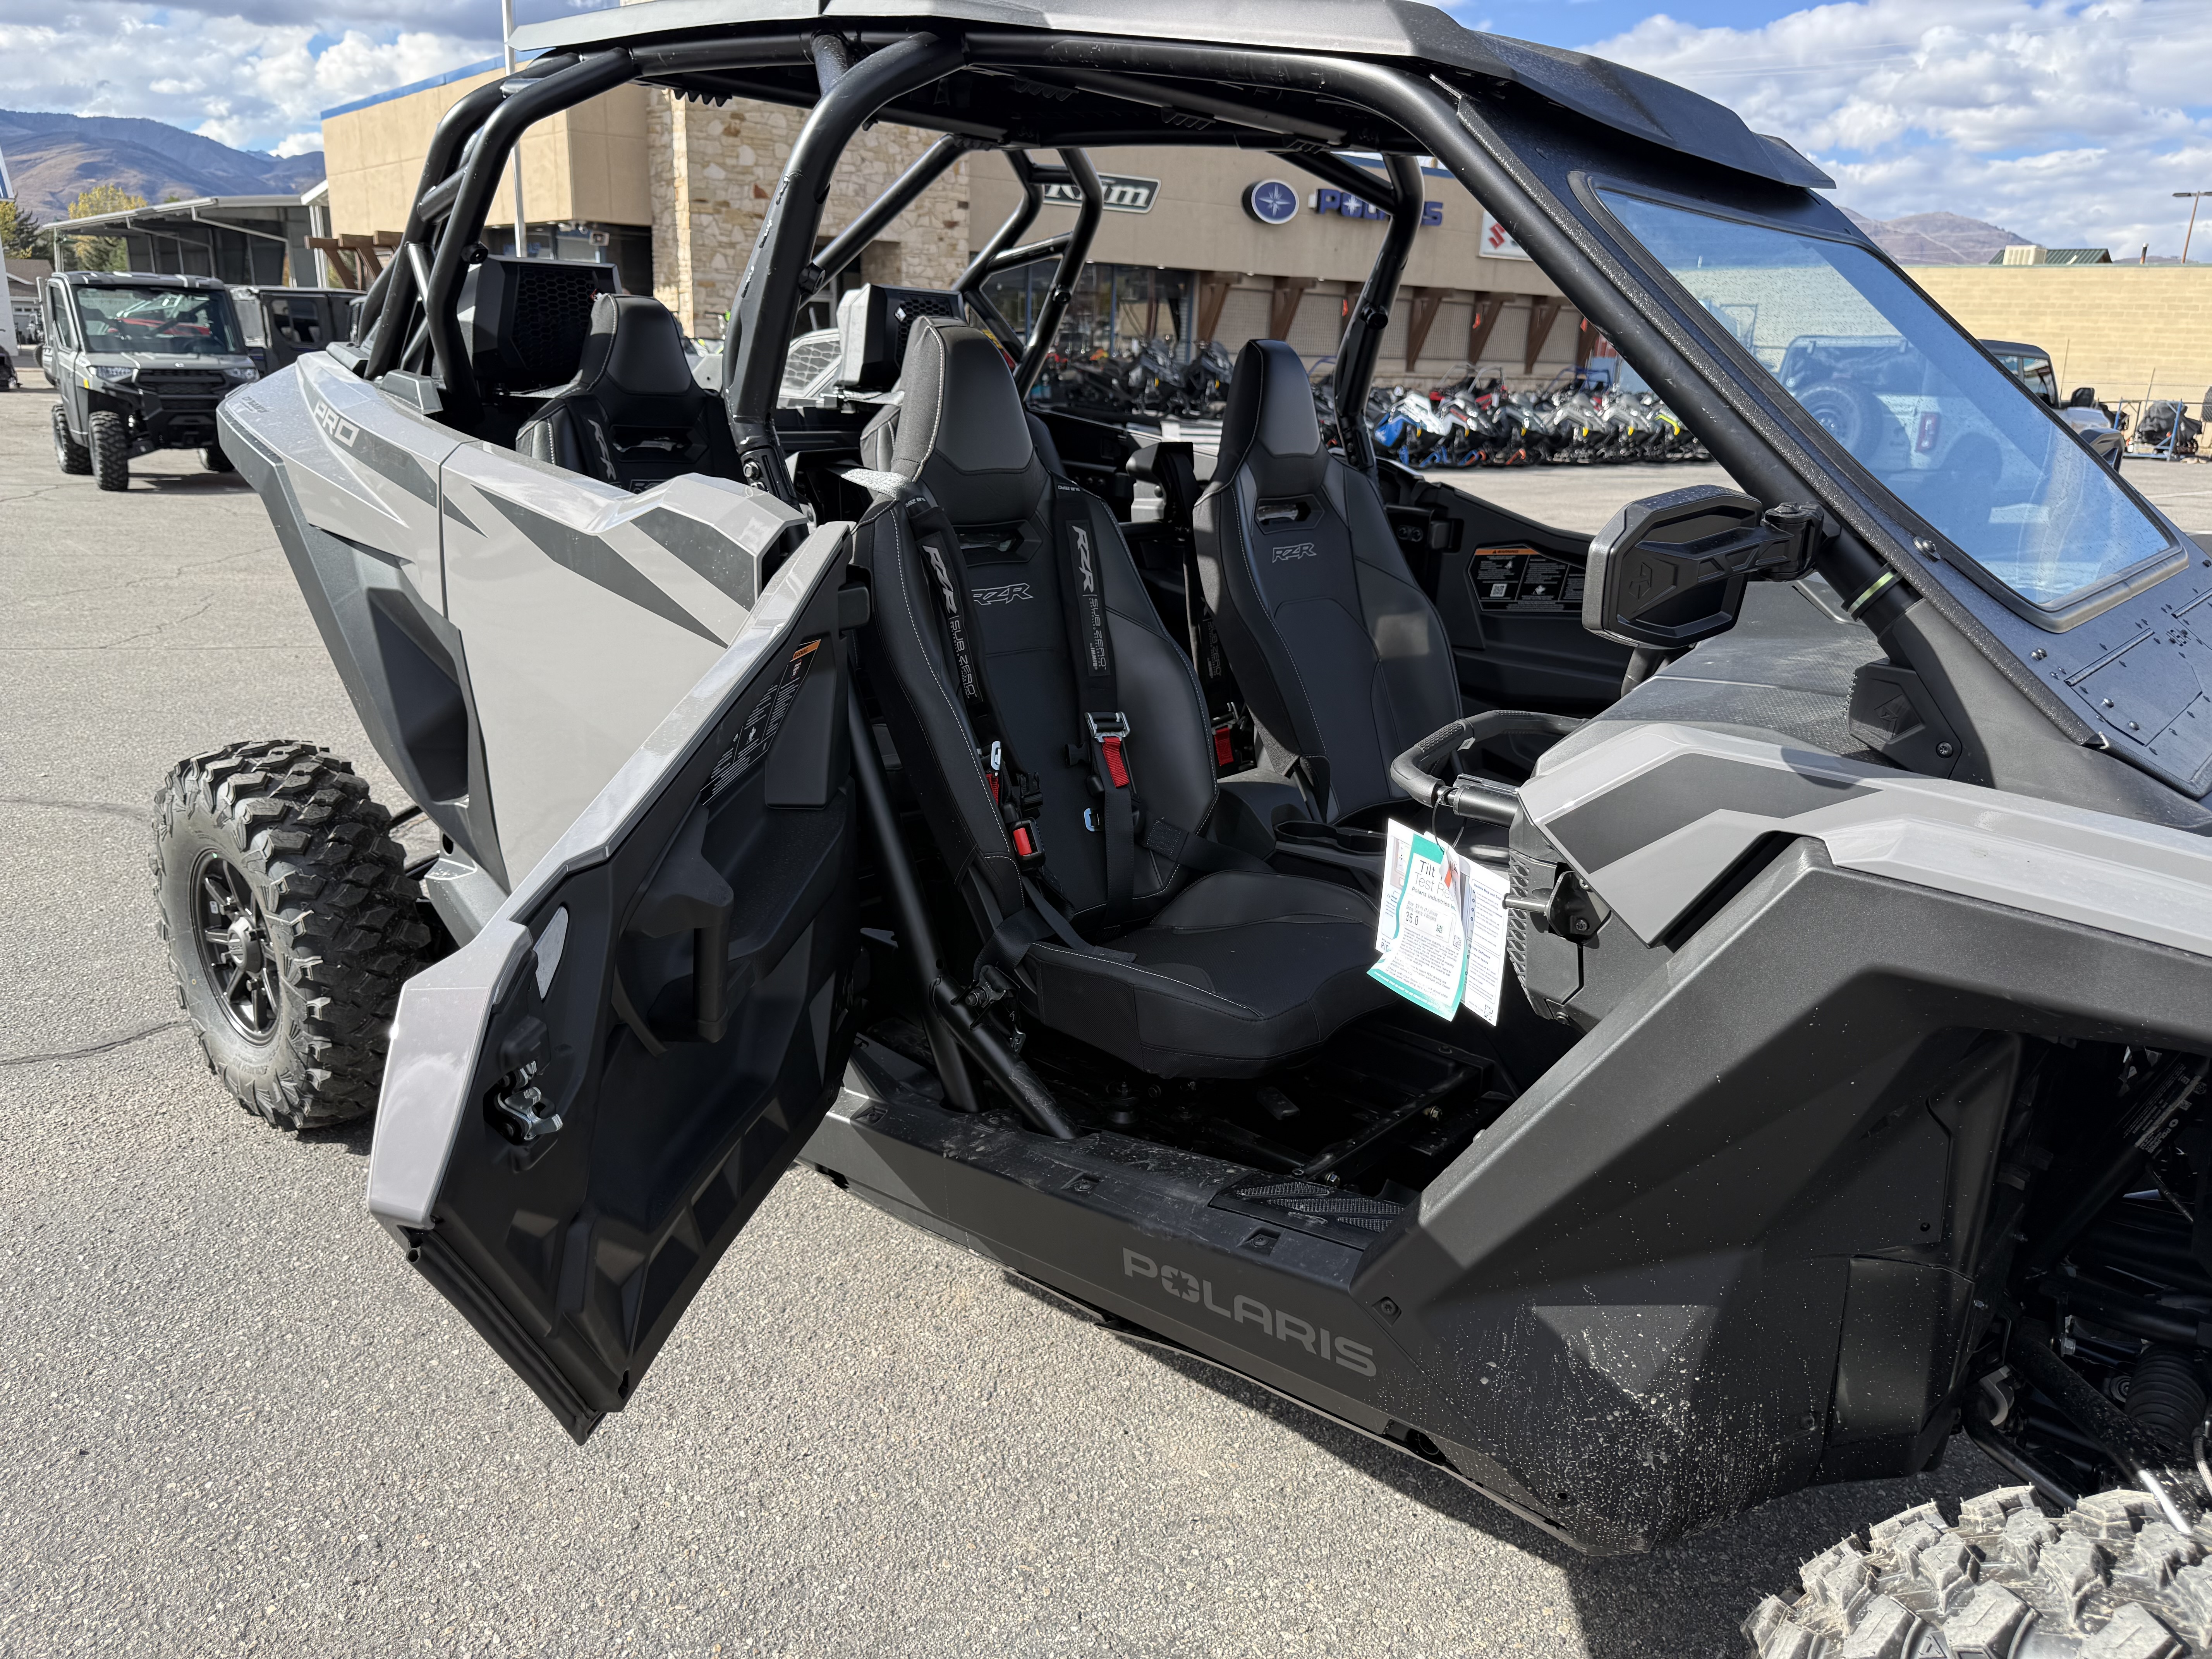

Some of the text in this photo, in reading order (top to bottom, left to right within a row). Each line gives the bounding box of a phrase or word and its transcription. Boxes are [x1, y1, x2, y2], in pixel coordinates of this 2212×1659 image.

[313, 400, 360, 447] PRO
[1072, 526, 1094, 593] RZR
[1272, 543, 1317, 563] RZR
[922, 546, 957, 614] RZR
[971, 583, 1034, 605] RZR
[952, 620, 965, 651] SUB
[1092, 598, 1106, 667] SUB ZERO
[1415, 871, 1435, 891] Test
[1420, 860, 1435, 878] Tilt
[1412, 886, 1427, 897] Polaris
[1428, 895, 1450, 907] Industries
[1405, 911, 1419, 926] 35.0
[1122, 1247, 1377, 1377] POLARIS
